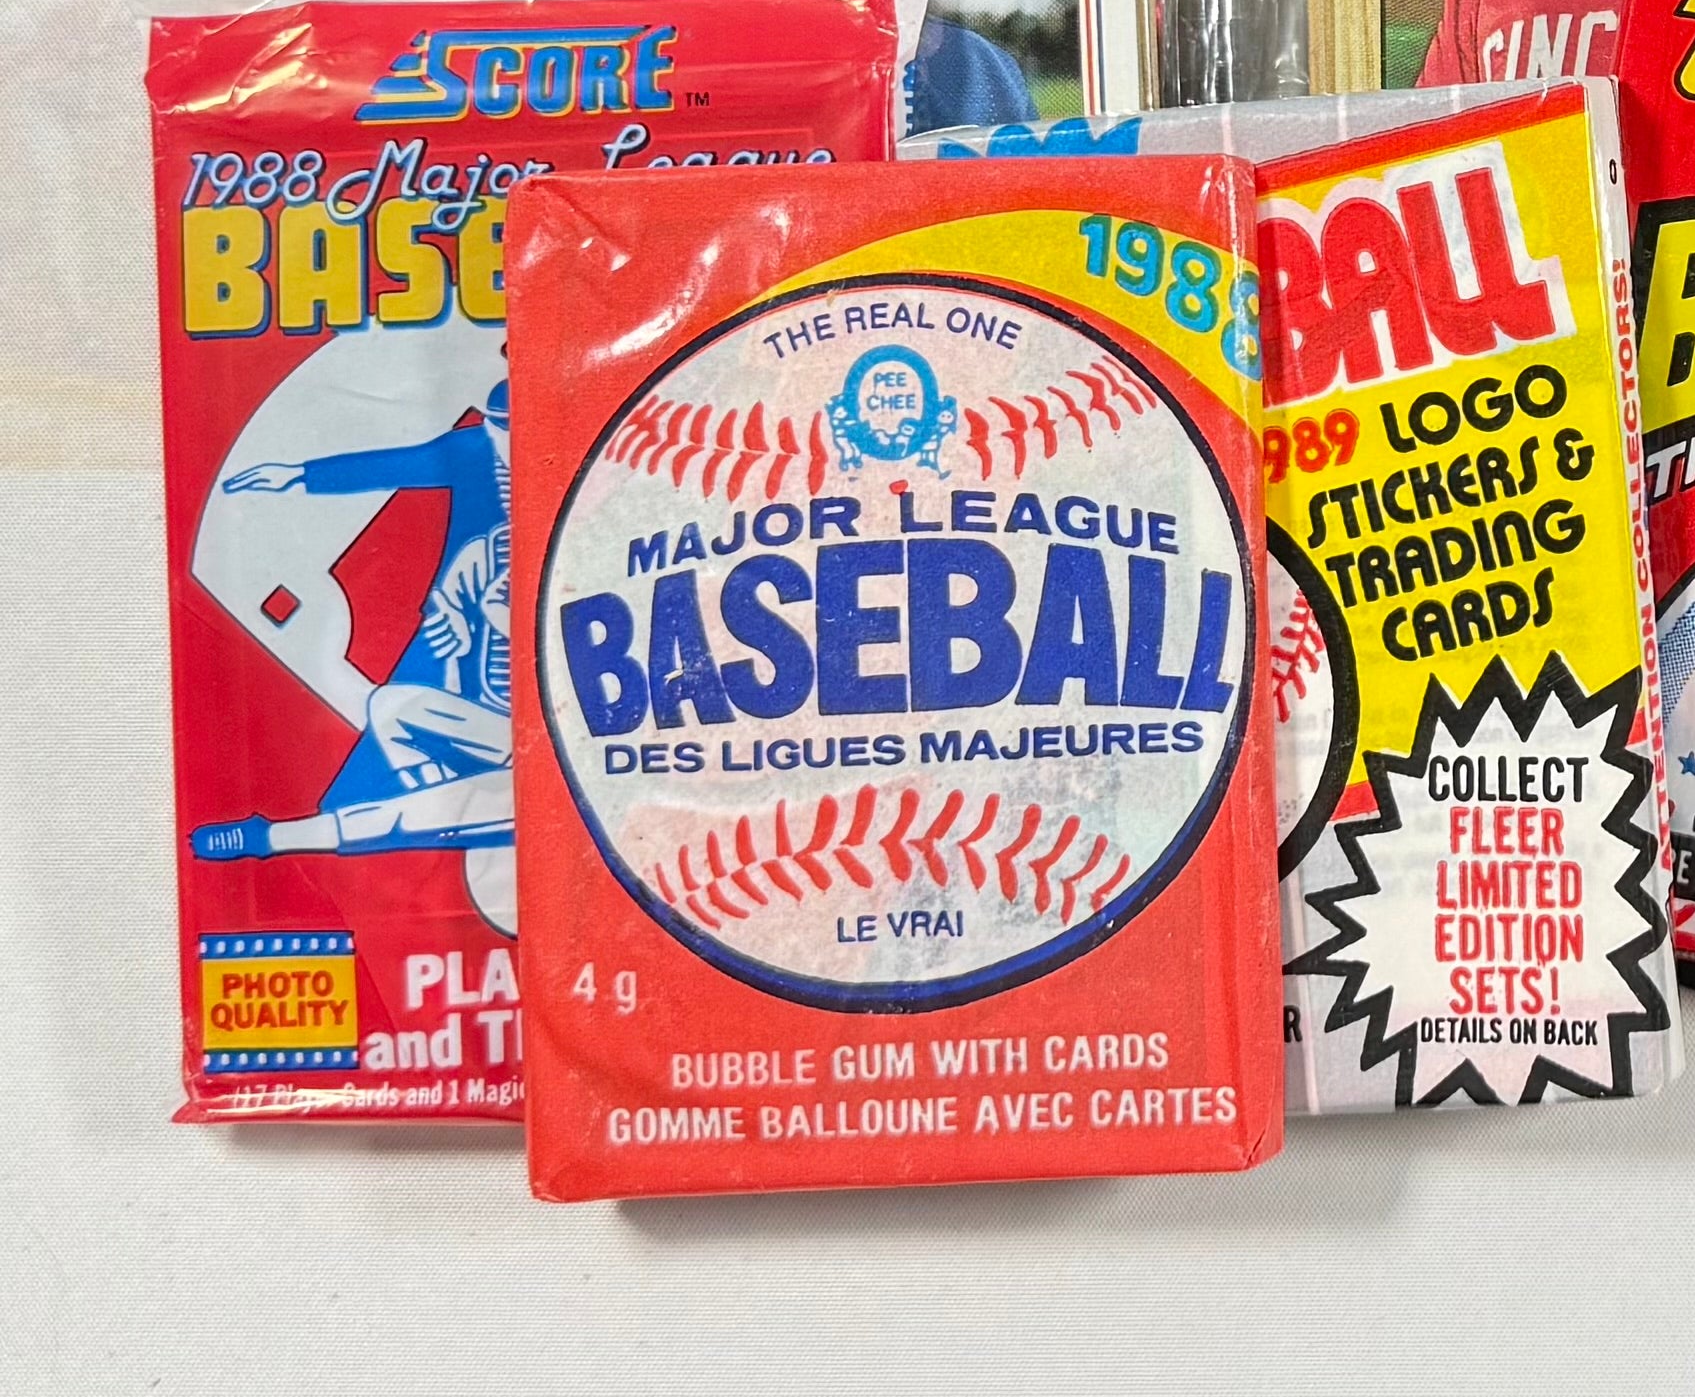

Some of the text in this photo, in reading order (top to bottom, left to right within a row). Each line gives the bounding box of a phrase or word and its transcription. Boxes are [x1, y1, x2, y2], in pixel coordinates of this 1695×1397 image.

[354, 25, 679, 125] SCORE
[182, 139, 554, 233] 1988 Major
[1079, 212, 1264, 380] 1988
[1257, 166, 1556, 408] BALL
[763, 302, 1023, 360] THE REAL ONE
[866, 393, 917, 413] CHEE
[872, 370, 907, 390] PEE
[1381, 364, 1567, 454] LOGO
[1613, 258, 1650, 593] COLLECTORS!
[1307, 427, 1595, 549] STICKERS &
[627, 489, 1180, 579] MAJOR LEAGUE
[1326, 499, 1585, 609] TRADING
[559, 537, 1235, 739] BASEBALL
[1382, 567, 1556, 663] CARDS
[603, 720, 1205, 775] DES LIGUES MAJEURES
[1428, 754, 1590, 803] COLLECT
[1449, 806, 1565, 856] FLEER
[1436, 860, 1583, 912] LIMITED
[837, 910, 964, 945] LE VRAI
[1434, 914, 1584, 964] EDITION
[222, 969, 335, 1000] PHOTO
[572, 962, 638, 1014] 4 g
[1449, 965, 1561, 1016] SETS!
[210, 1001, 349, 1032] QUALITY
[364, 1012, 462, 1071] and
[1420, 1016, 1599, 1046] DETAILS ON BACK
[671, 1031, 1170, 1090] BUBBLE GUM WITH CARDS
[341, 1079, 460, 1109] Cards and 1
[607, 1086, 1238, 1147] GOMME BALLOUNE AVEC CARTES
